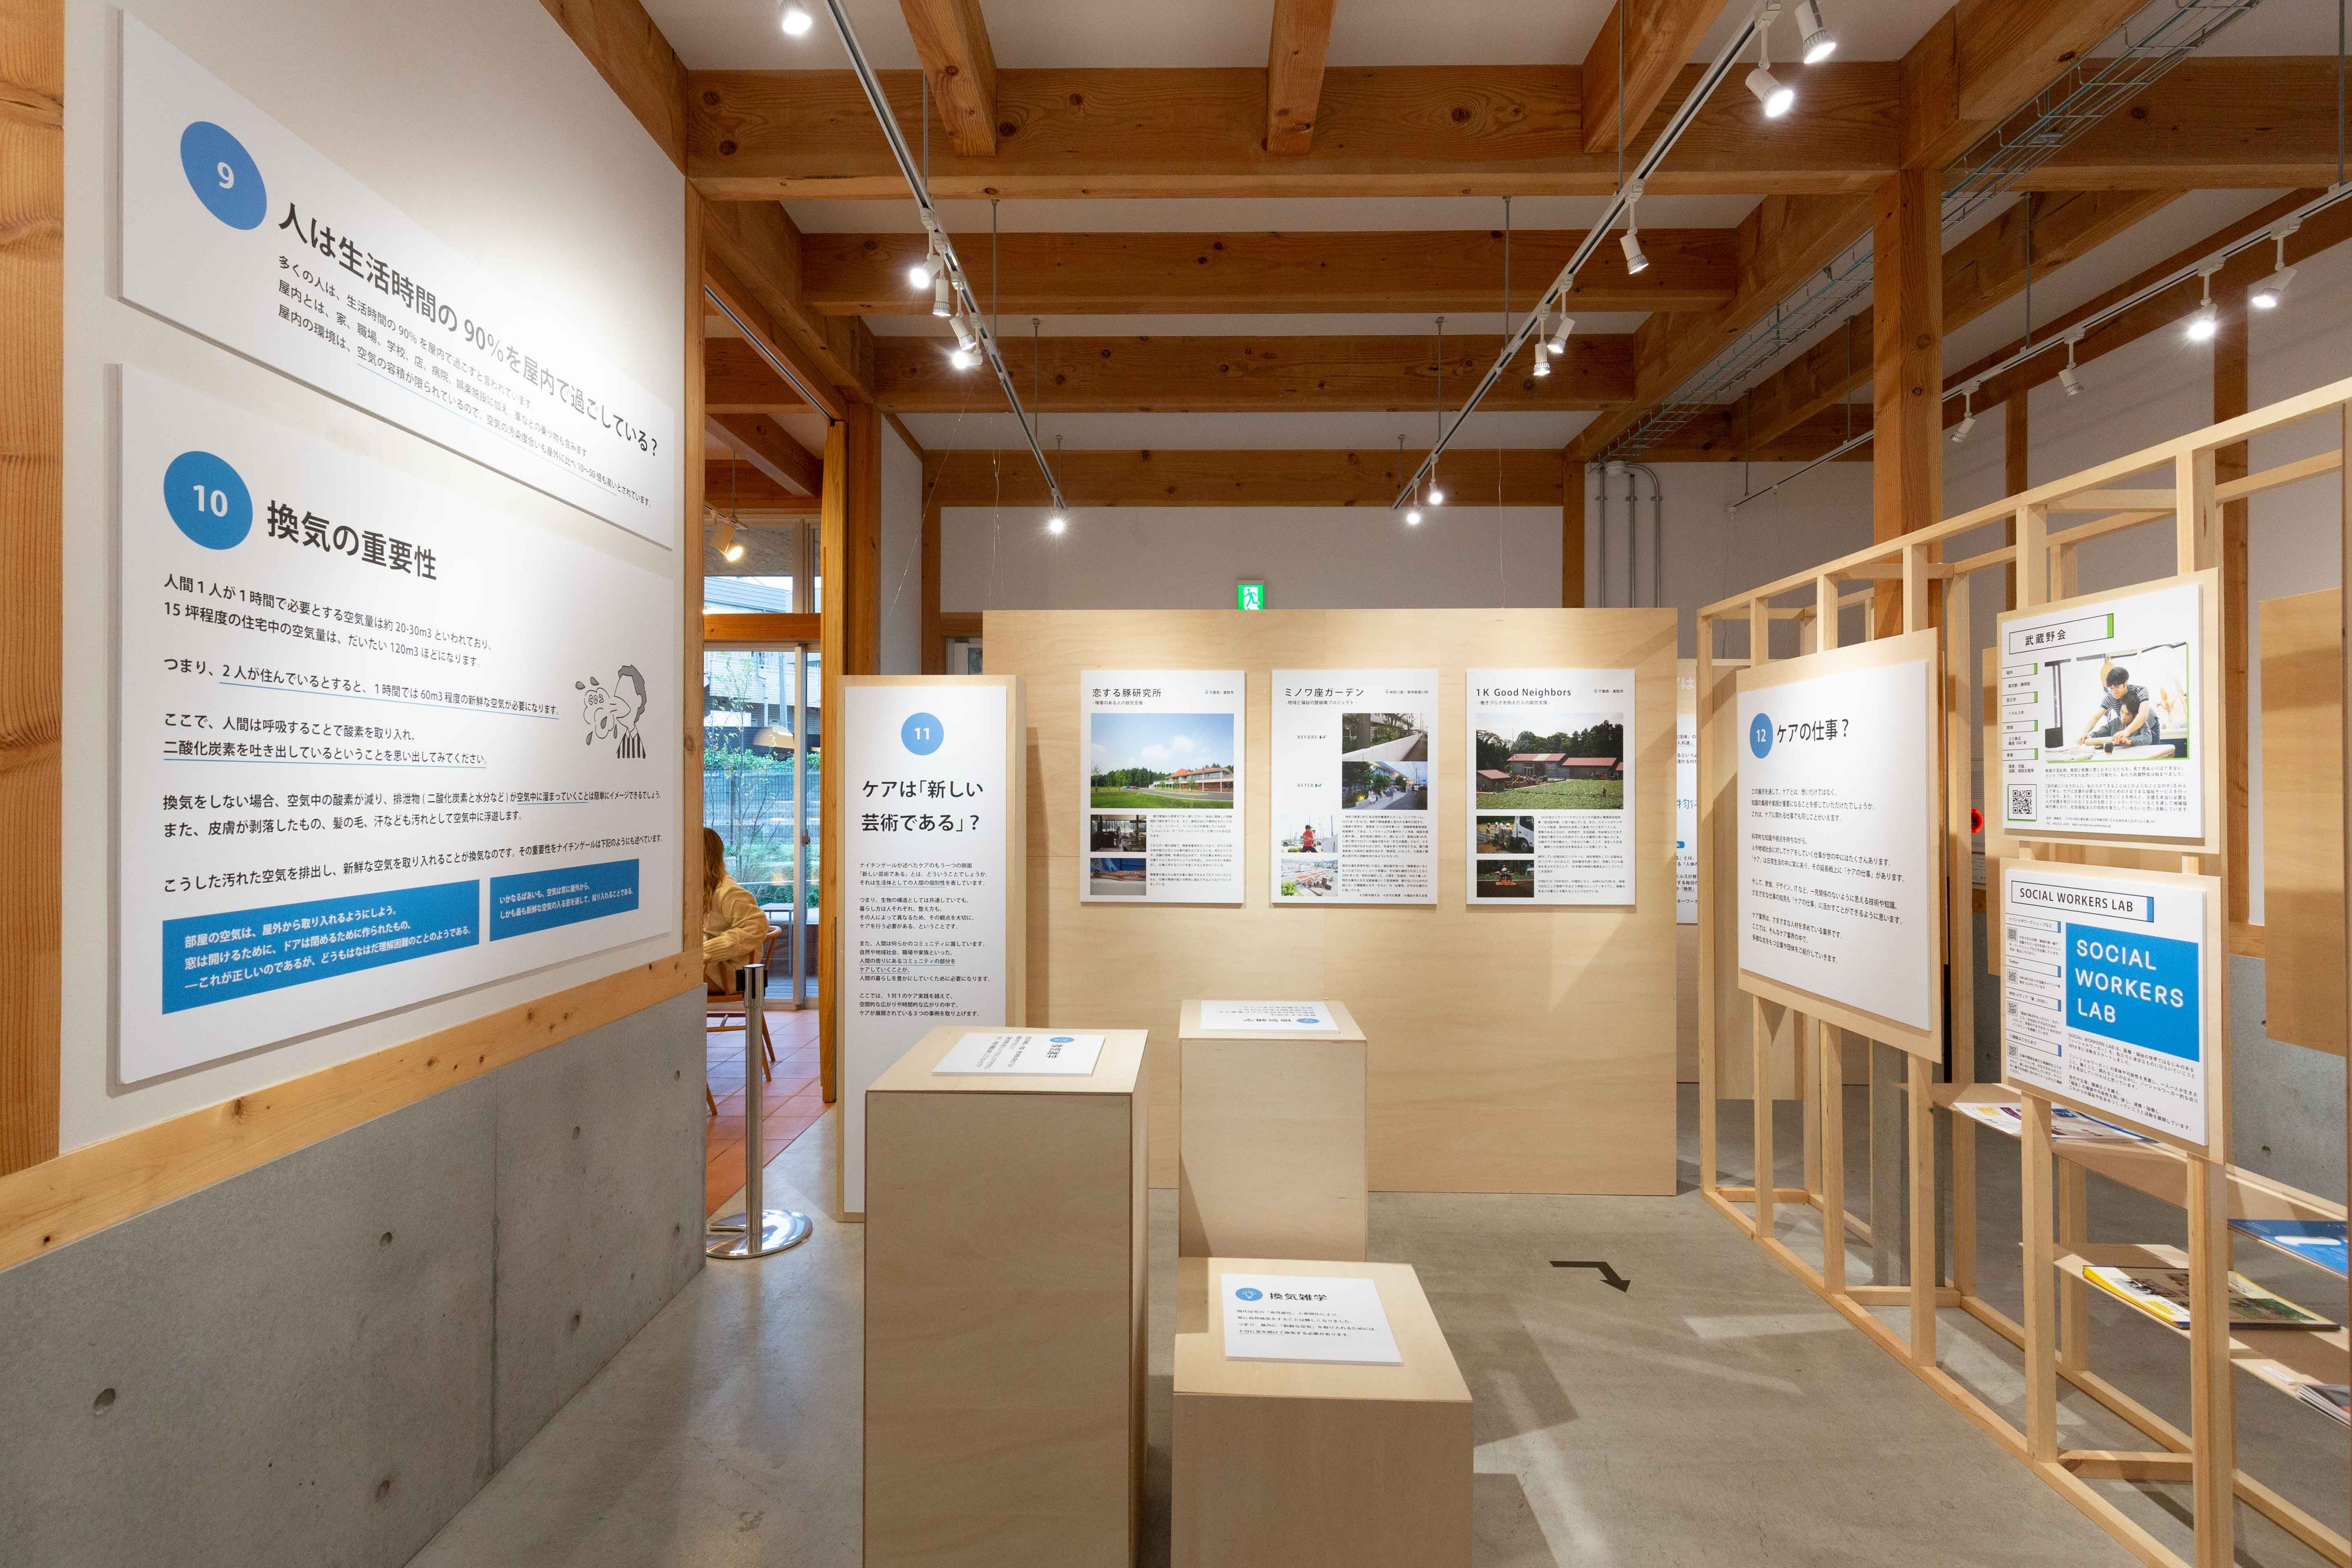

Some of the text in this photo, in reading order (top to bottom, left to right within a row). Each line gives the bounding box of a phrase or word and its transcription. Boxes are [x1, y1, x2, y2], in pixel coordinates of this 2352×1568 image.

[217, 161, 235, 189] 9
[193, 484, 228, 517] 10
[267, 500, 437, 580] 換気の重要性
[2025, 629, 2066, 646] 武蔵野会
[1092, 688, 1162, 698] 恋する豚研究所
[1285, 688, 1364, 697] ミノワ座ガーデン
[1494, 688, 1519, 697] Good
[1522, 688, 1571, 698] Neighbors
[165, 713, 415, 741] ここで、人間は呼吸することで酸素を取り入れ、
[914, 727, 931, 740] 11
[1756, 729, 1766, 742] 12
[163, 741, 487, 765] 二酸化炭素を吐き出しているということを思い出してみてください。
[862, 780, 984, 798] ケアは「新しい
[861, 814, 980, 832] 芸術である」？
[2020, 888, 2133, 912] SOCIAL WORKERS LAB
[185, 905, 396, 949] 部屋の空気は、屋外から取り入れるようにしよう。
[2076, 939, 2157, 970] SOCIAL
[2075, 969, 2184, 1008] WORKERS
[2078, 998, 2116, 1023] LAB
[1269, 1292, 1327, 1302] 換気雑学
